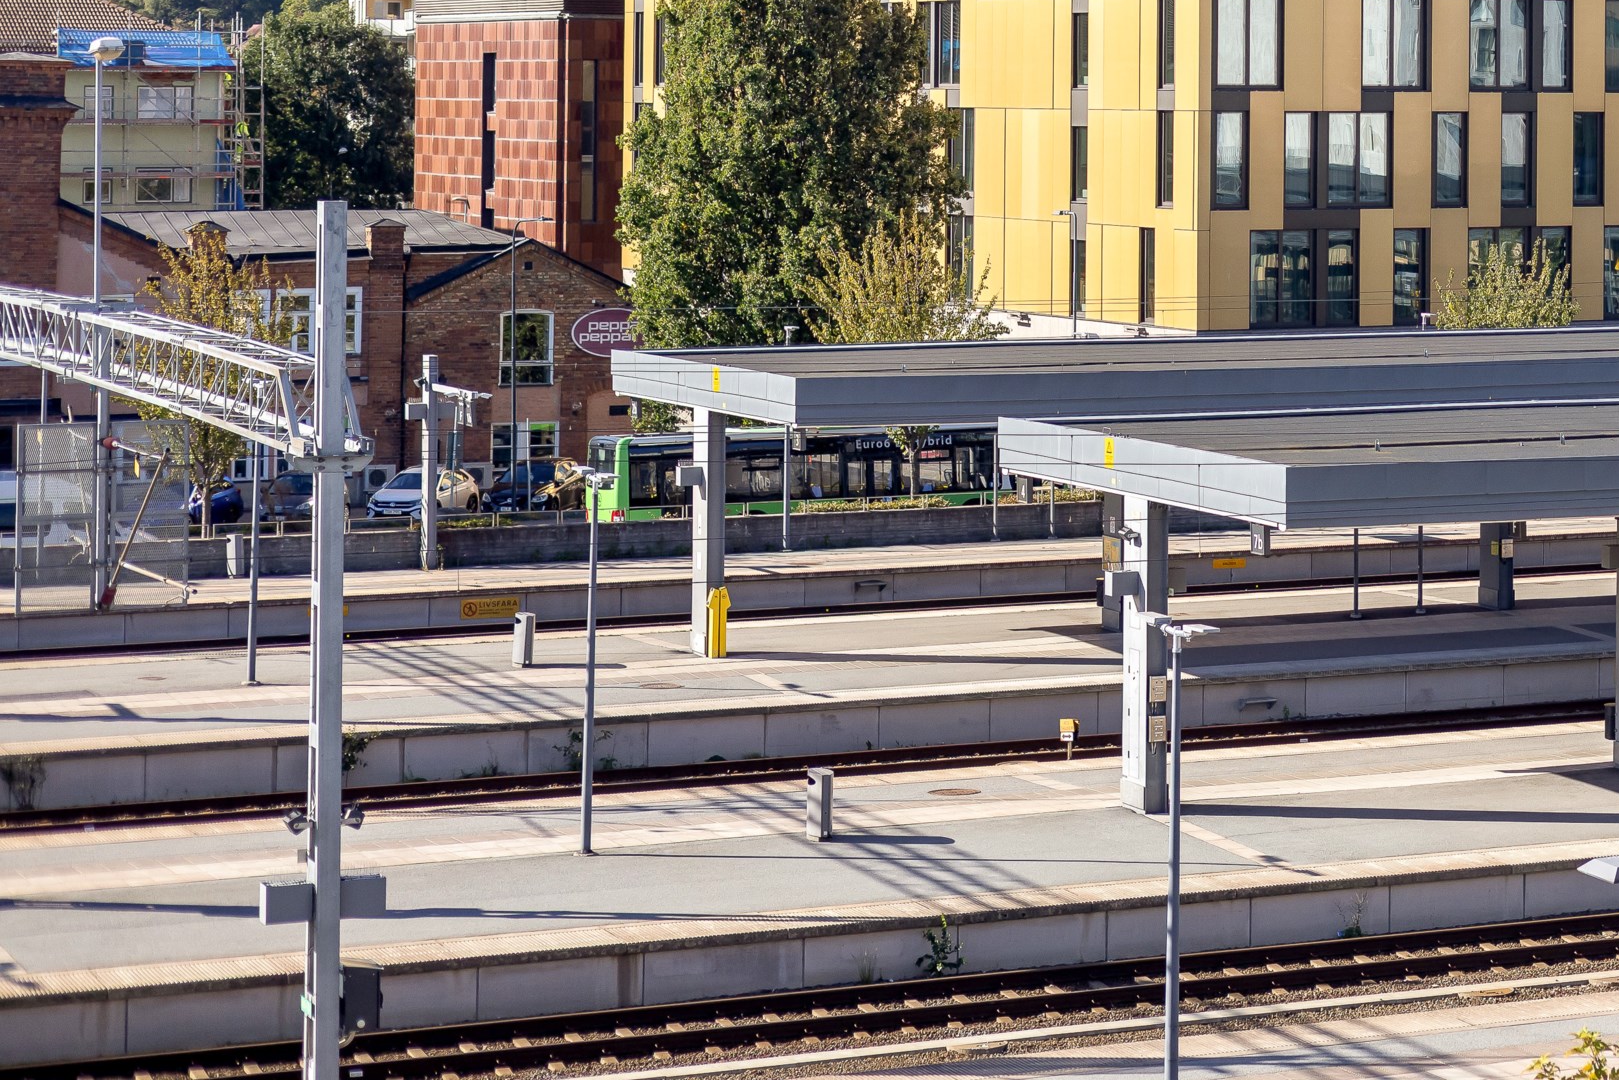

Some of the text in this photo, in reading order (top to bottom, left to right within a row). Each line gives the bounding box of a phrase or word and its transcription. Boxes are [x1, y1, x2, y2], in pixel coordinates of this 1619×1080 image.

[588, 321, 639, 333] peppa
[579, 332, 635, 344] peppa
[855, 438, 891, 450] Euro6
[1253, 533, 1263, 550] 7b
[478, 600, 518, 609] LIVSFARA
